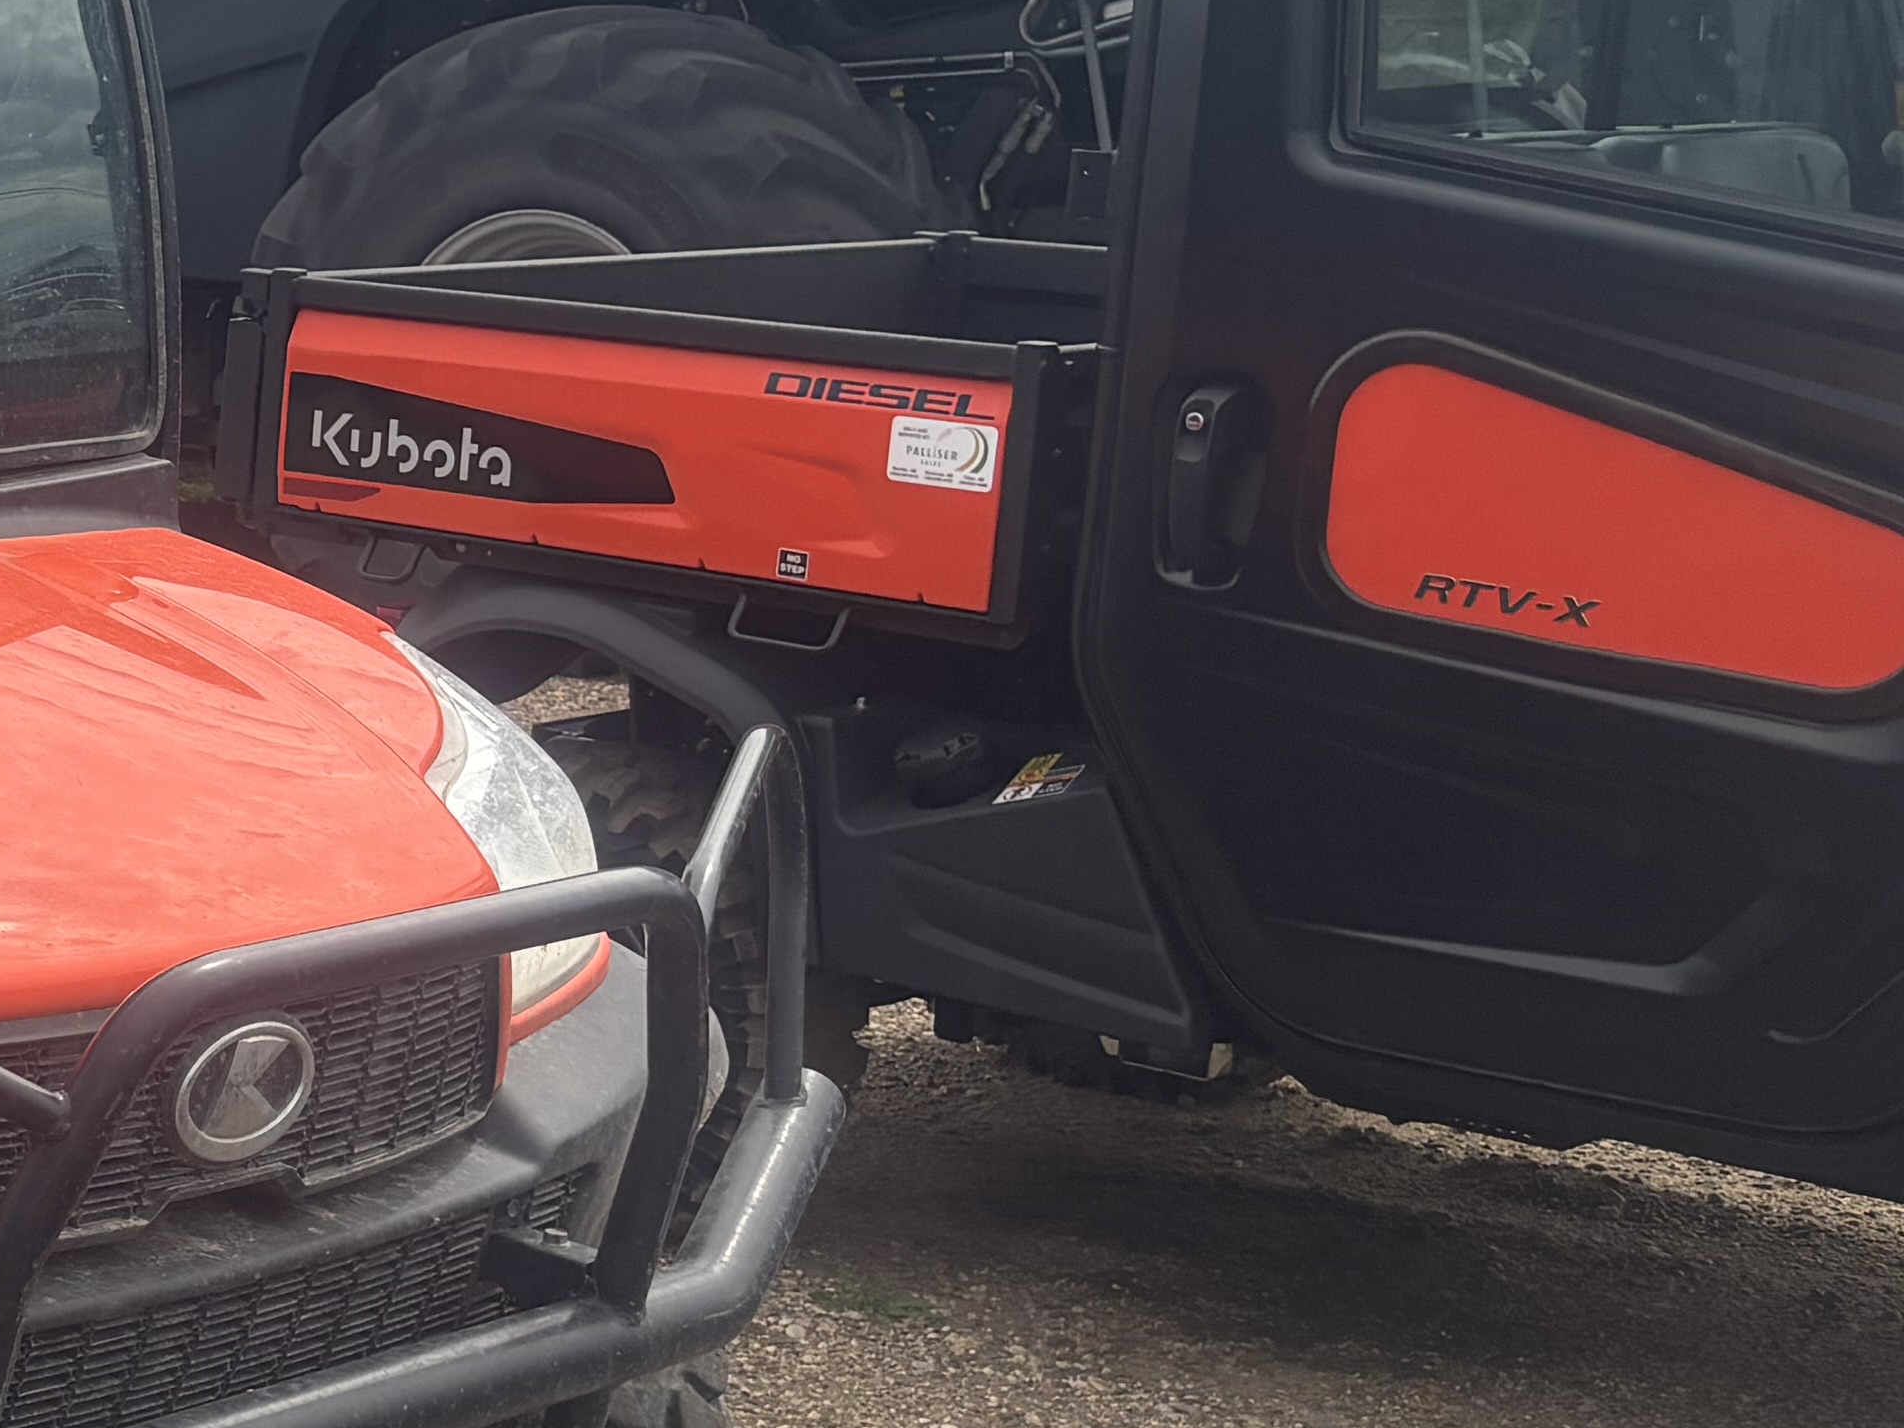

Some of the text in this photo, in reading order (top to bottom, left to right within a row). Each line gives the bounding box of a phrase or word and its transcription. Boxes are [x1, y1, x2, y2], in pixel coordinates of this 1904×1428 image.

[764, 372, 995, 421] DIESEL
[311, 409, 512, 487] Kubota
[905, 445, 958, 461] PALLISER
[780, 563, 804, 574] STEP
[786, 553, 801, 564] NO
[1415, 573, 1602, 628] RTV-X
